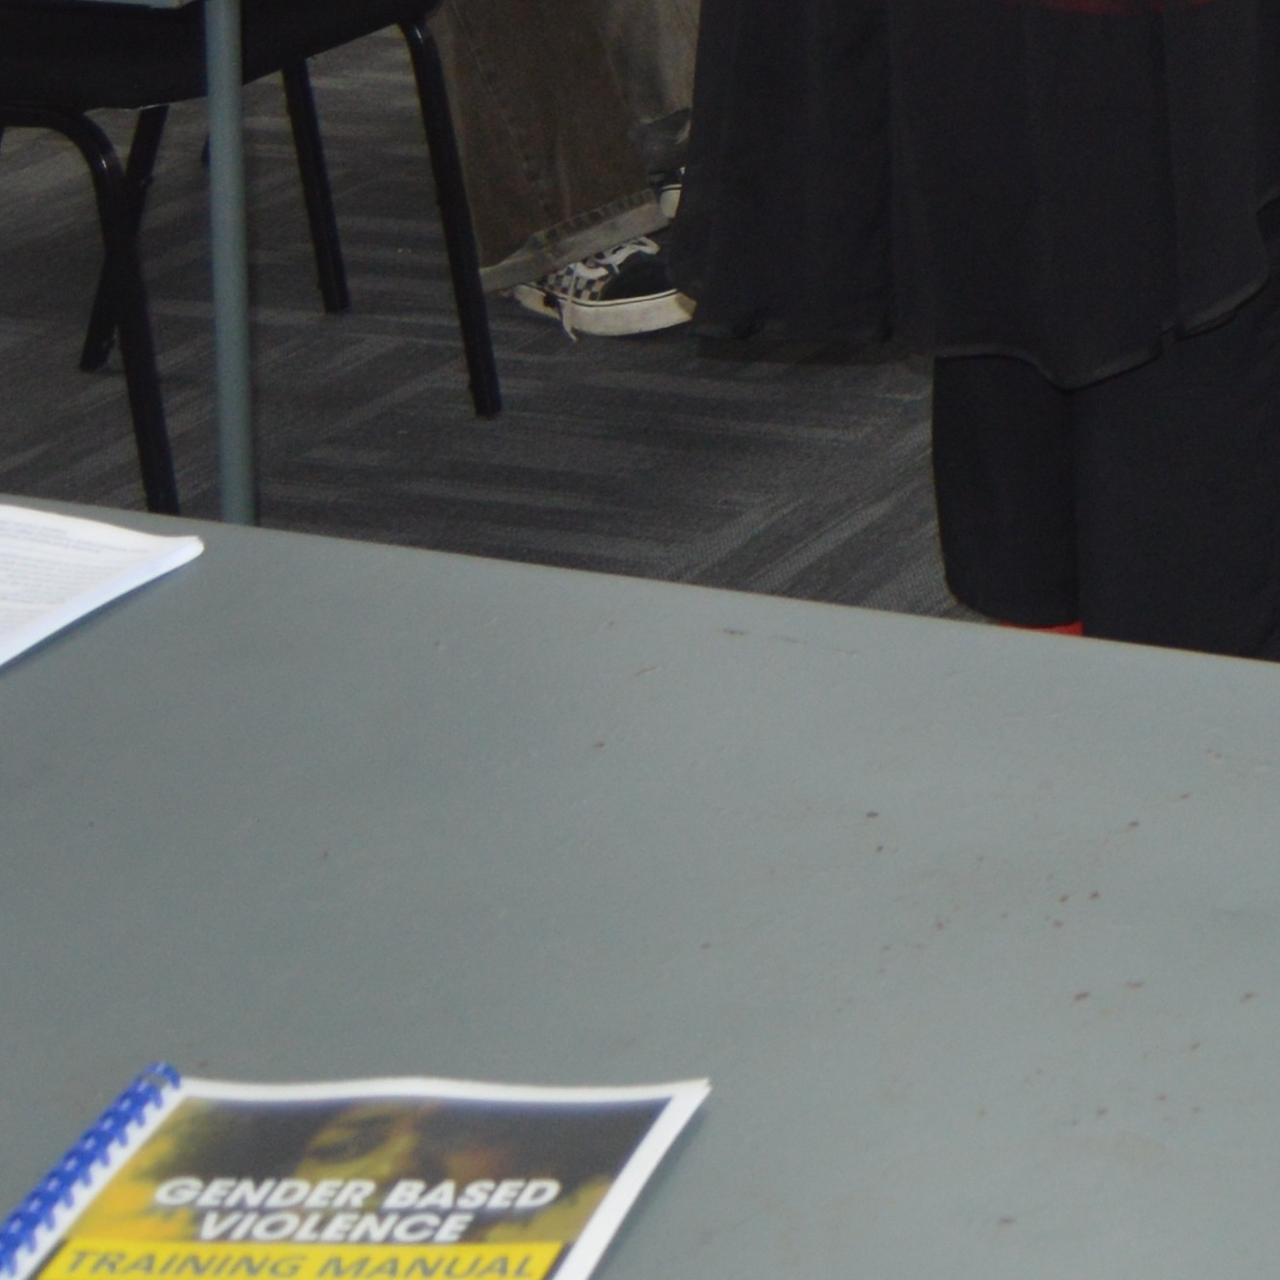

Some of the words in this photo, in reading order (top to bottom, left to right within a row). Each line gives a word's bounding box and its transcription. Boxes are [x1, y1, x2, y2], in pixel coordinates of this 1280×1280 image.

[154, 1176, 376, 1209] GENDER
[381, 1178, 561, 1209] BASED
[198, 1212, 474, 1242] VIOLENCE
[66, 1250, 305, 1279] TRAINING
[316, 1254, 534, 1279] MANUAL
